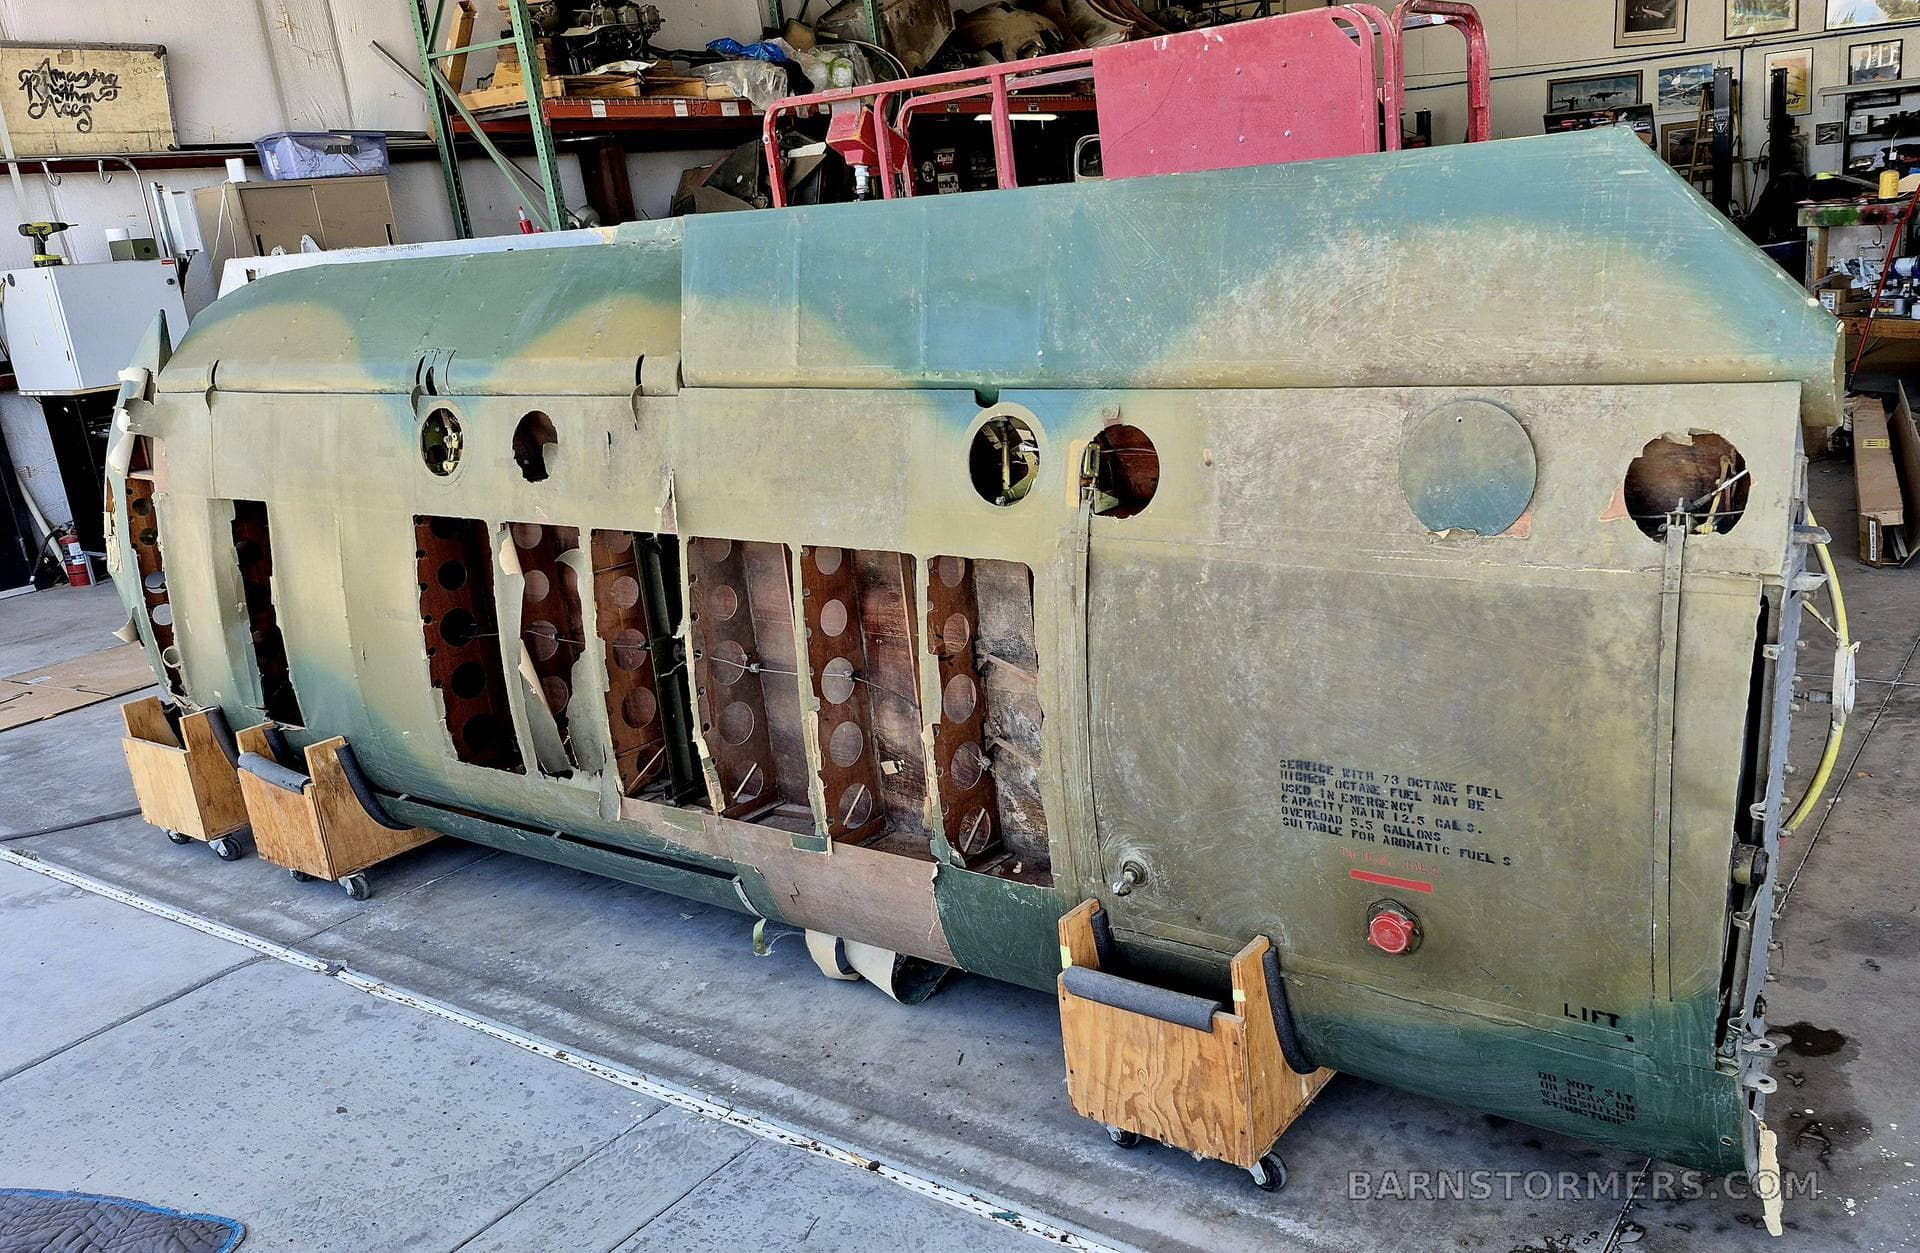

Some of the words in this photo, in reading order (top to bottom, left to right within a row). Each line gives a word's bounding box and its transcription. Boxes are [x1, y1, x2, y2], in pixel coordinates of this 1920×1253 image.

[32, 58, 122, 88] Amazing
[28, 96, 92, 133] Aces
[1280, 759, 1334, 775] SERVICE
[1342, 768, 1374, 781] WITH
[1383, 775, 1399, 785] 73
[1408, 777, 1457, 793] OCTANE
[1466, 785, 1503, 799] FUEL
[1281, 770, 1326, 786] HIGHER
[1335, 780, 1380, 795] OCTANE
[1390, 788, 1422, 802] FUEL
[1433, 796, 1458, 807] MAY
[1468, 801, 1486, 811] BE
[1282, 783, 1311, 796] USED
[1321, 790, 1335, 801] IN
[1341, 793, 1414, 812] EMERGENCY
[1282, 795, 1344, 812] CAPACITY
[1352, 807, 1384, 820] MAIN
[1394, 813, 1425, 826] 12.5
[1282, 807, 1342, 824] OVERLOAD
[1350, 818, 1373, 830] 5.5
[1383, 823, 1441, 841] GALLONS
[1282, 817, 1343, 837] SUITABLE
[1351, 830, 1375, 842] FOR
[1383, 836, 1449, 855] AROMATIC
[1564, 1003, 1620, 1029] LIFT
[1539, 1071, 1556, 1082] DO
[1567, 1079, 1594, 1092] NOT
[1604, 1088, 1633, 1102] SIT
[1540, 1081, 1558, 1091] OR
[1568, 1089, 1605, 1104] LEAN
[1616, 1102, 1635, 1112] ON
[1541, 1089, 1635, 1120] WINDSHIELD
[1542, 1098, 1626, 1127] STRUCTURE
